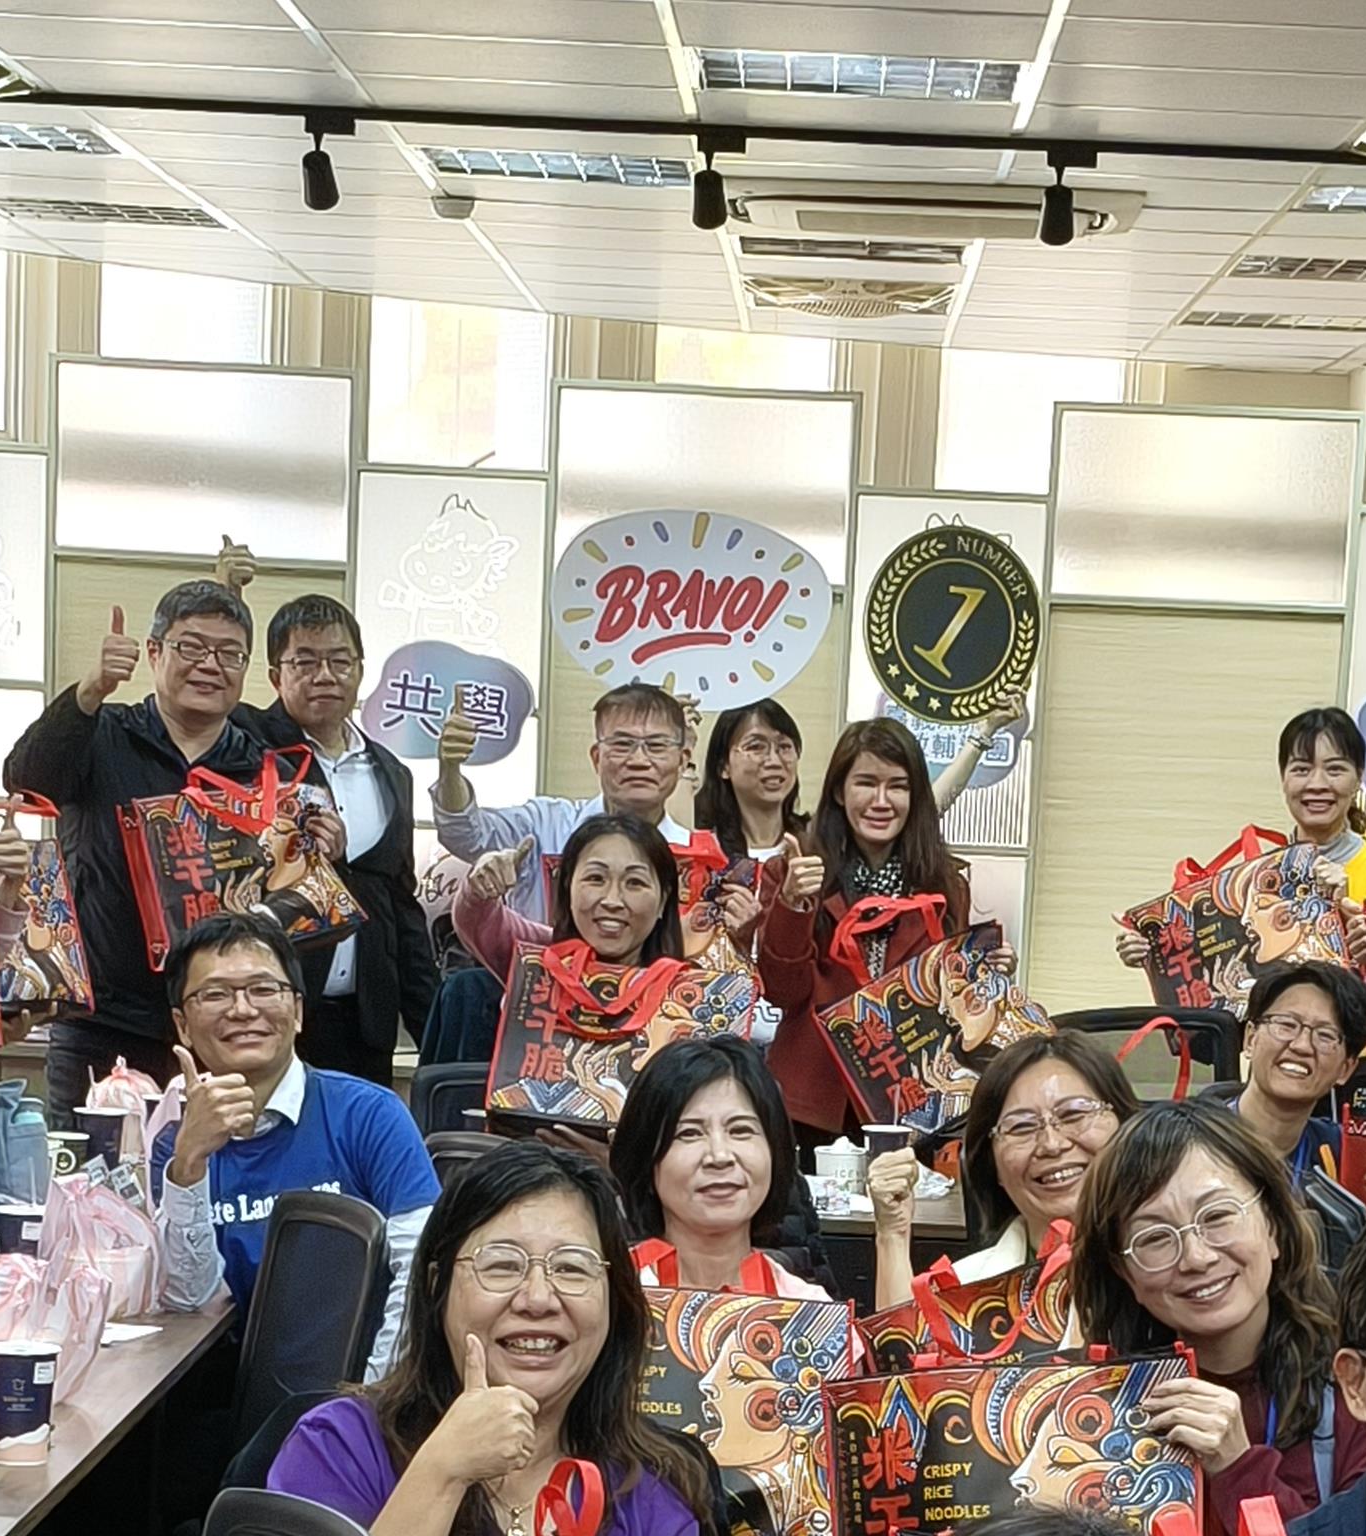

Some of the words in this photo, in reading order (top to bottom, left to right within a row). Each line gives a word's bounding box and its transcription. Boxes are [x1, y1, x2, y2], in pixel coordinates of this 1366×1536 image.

[956, 535, 1028, 600] NUMBER
[594, 564, 789, 642] BRAVO!
[913, 585, 986, 678] 1
[382, 673, 505, 736] 共學
[923, 1462, 972, 1479] CRISPY
[923, 1484, 953, 1499] RICE
[925, 1504, 990, 1521] NOODLES
